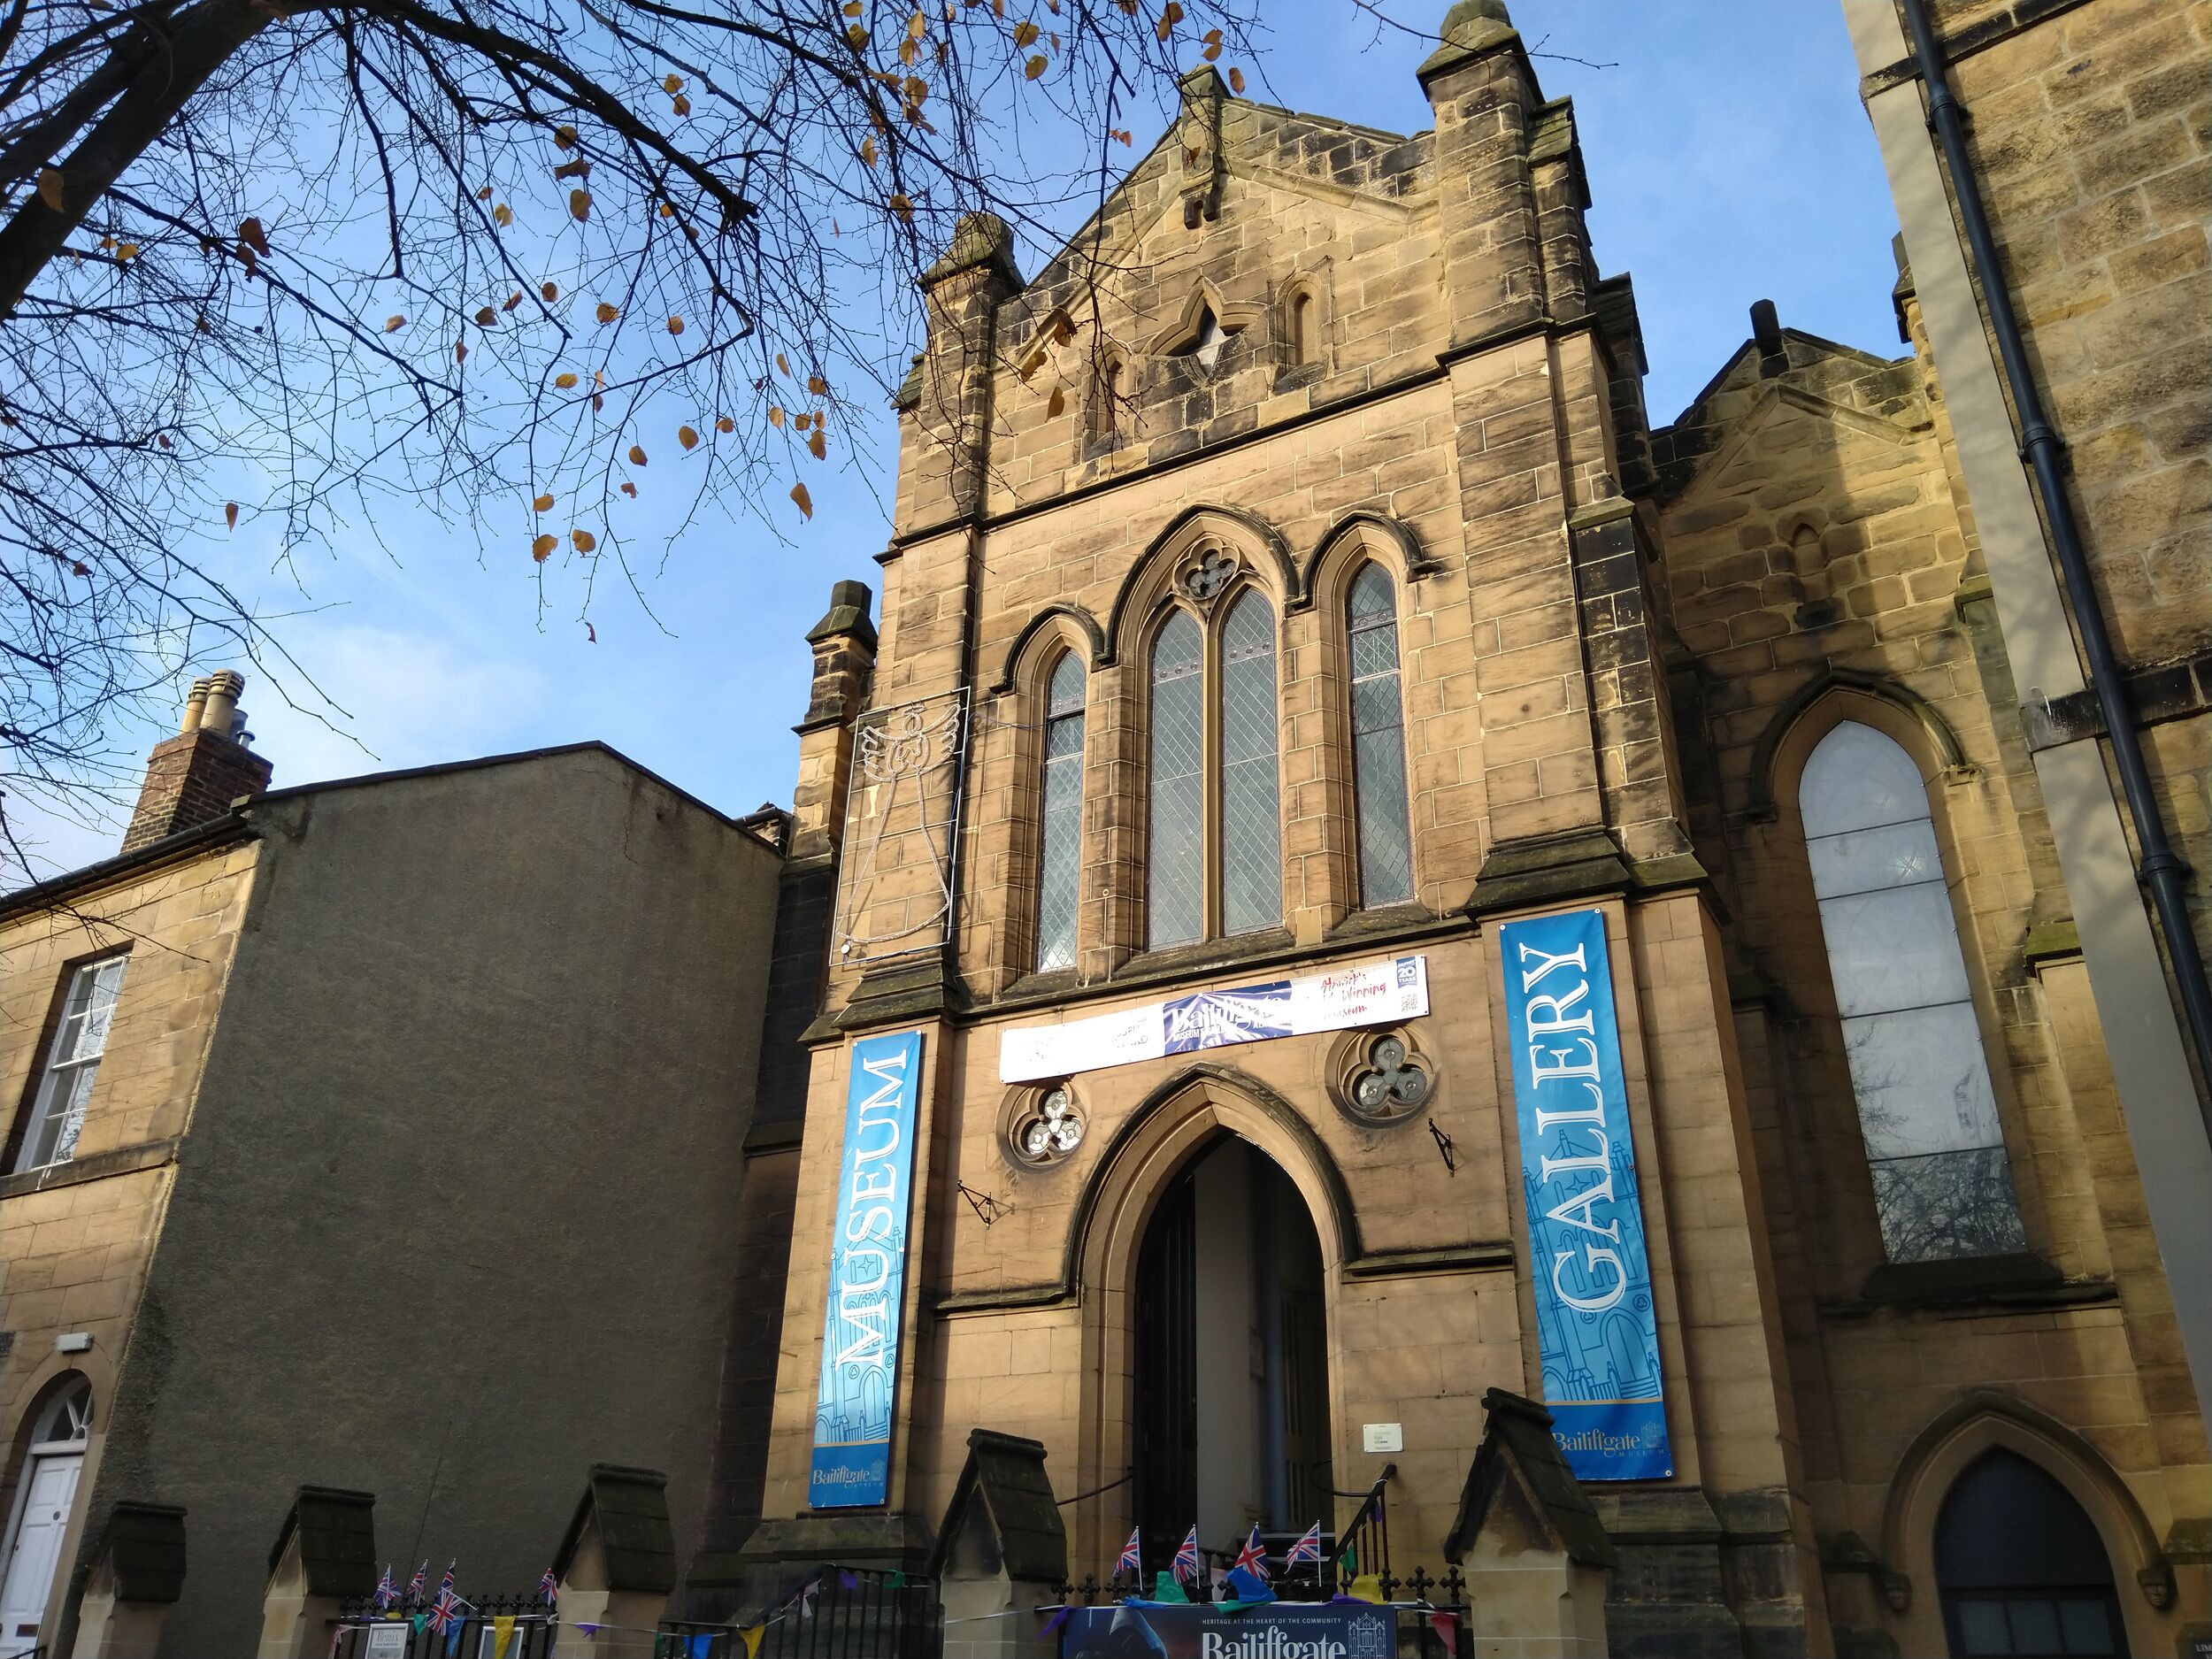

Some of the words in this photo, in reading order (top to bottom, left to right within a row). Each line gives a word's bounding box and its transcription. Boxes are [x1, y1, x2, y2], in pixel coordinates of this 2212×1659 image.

[1398, 966, 1417, 979] 20
[1172, 1028, 1201, 1042] MUSEUM
[1519, 942, 1626, 1312] GALLERY
[835, 1048, 907, 1371] MUSEUM
[1552, 1429, 1640, 1457] Bailiffgate
[812, 1465, 870, 1488] Bailiffgate
[1202, 1625, 1347, 1659] Bailiffgate
